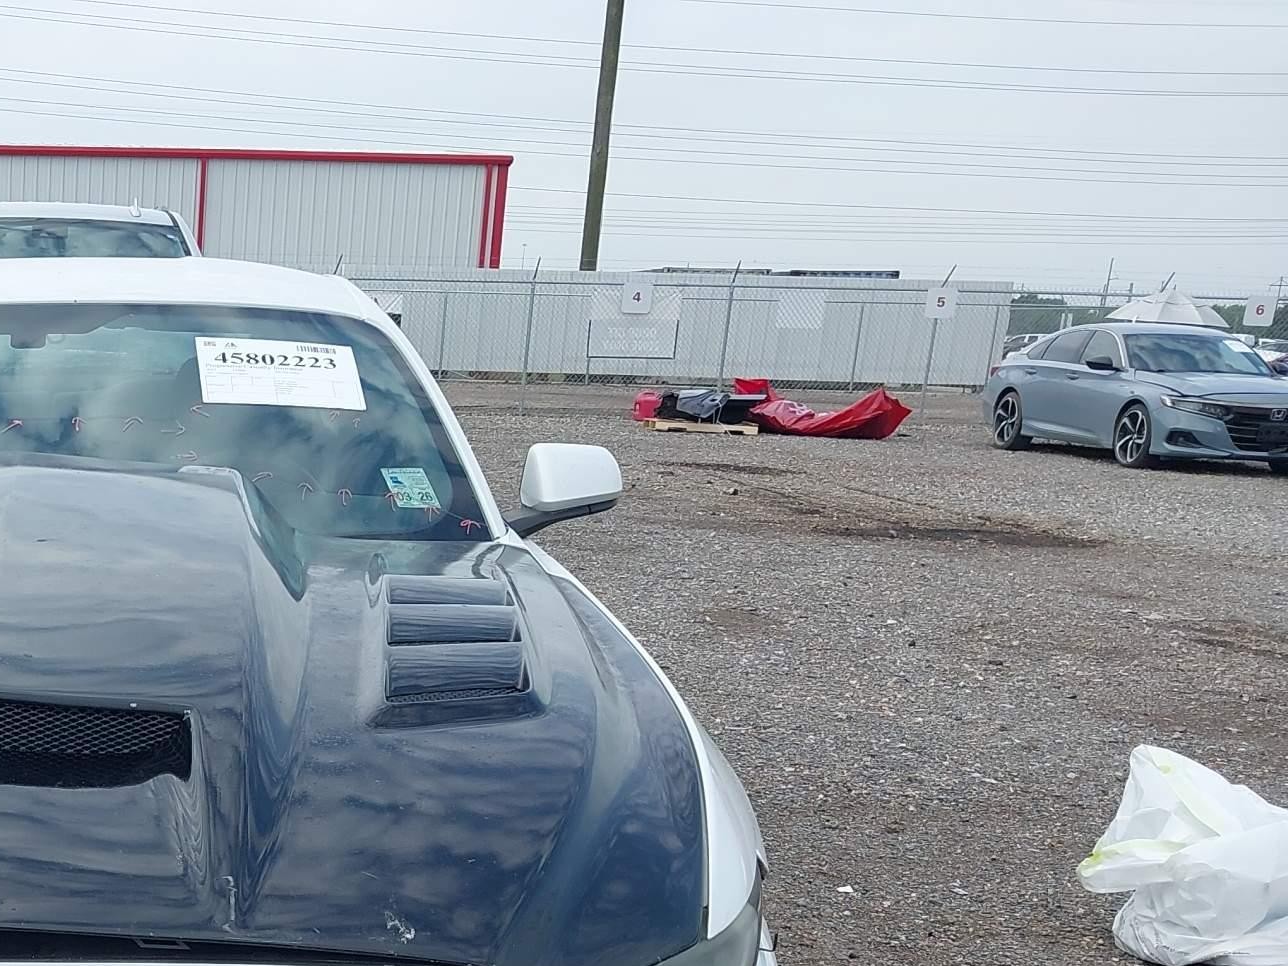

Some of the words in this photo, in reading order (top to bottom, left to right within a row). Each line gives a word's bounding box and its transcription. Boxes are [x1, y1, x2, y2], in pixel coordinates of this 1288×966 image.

[632, 291, 642, 303] 4
[936, 296, 946, 308] 5
[1256, 305, 1264, 315] 6
[214, 351, 337, 370] 45802223
[396, 491, 412, 502] 03
[417, 491, 434, 502] 26
